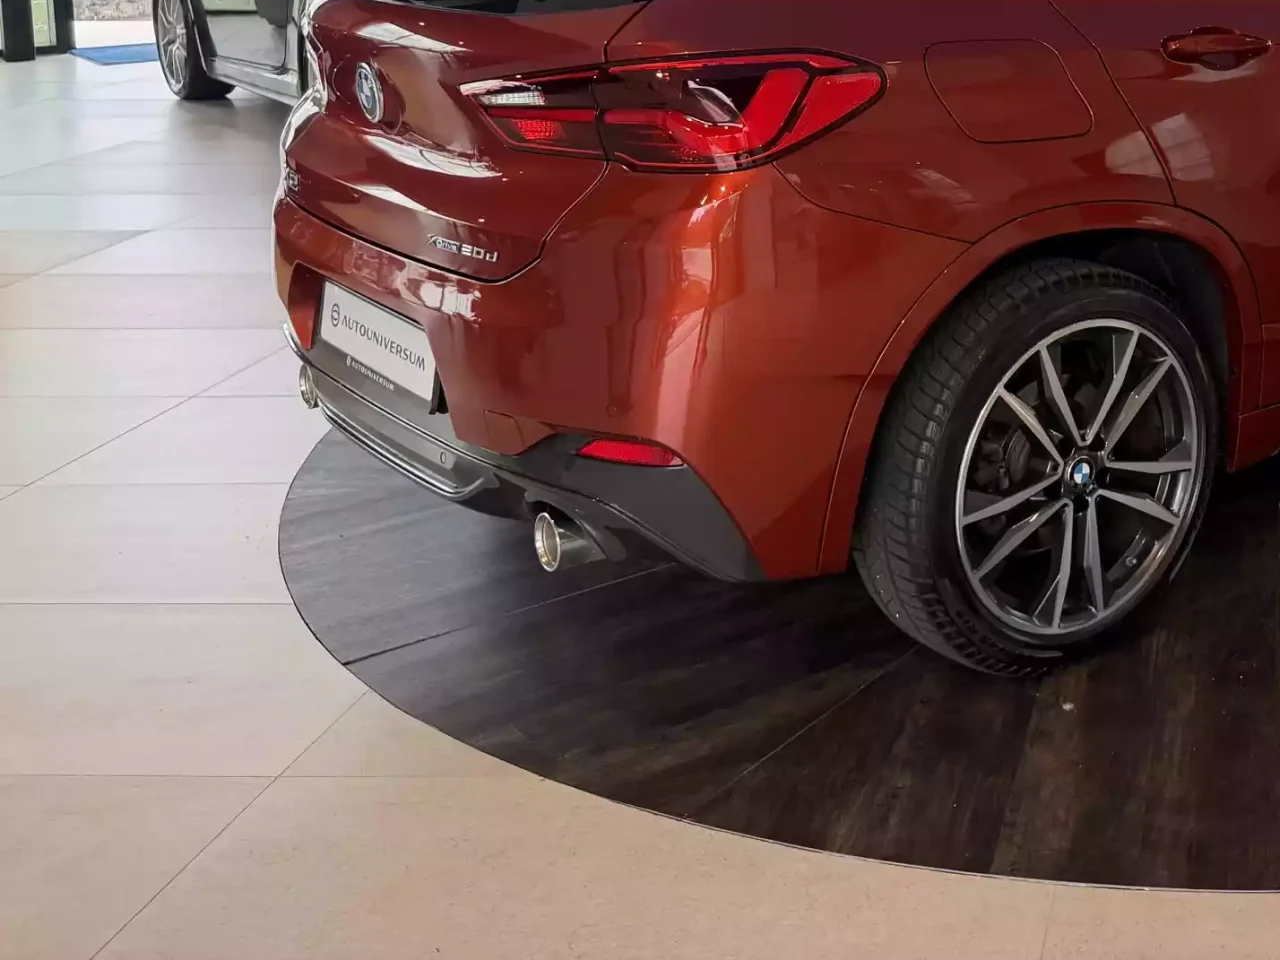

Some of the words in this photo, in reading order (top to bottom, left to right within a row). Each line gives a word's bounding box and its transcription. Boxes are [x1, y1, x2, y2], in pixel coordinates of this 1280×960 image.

[461, 243, 498, 262] 20d
[341, 314, 426, 372] AUTOUNIVERSUM
[351, 360, 395, 392] AUTOUNIVERSUM
